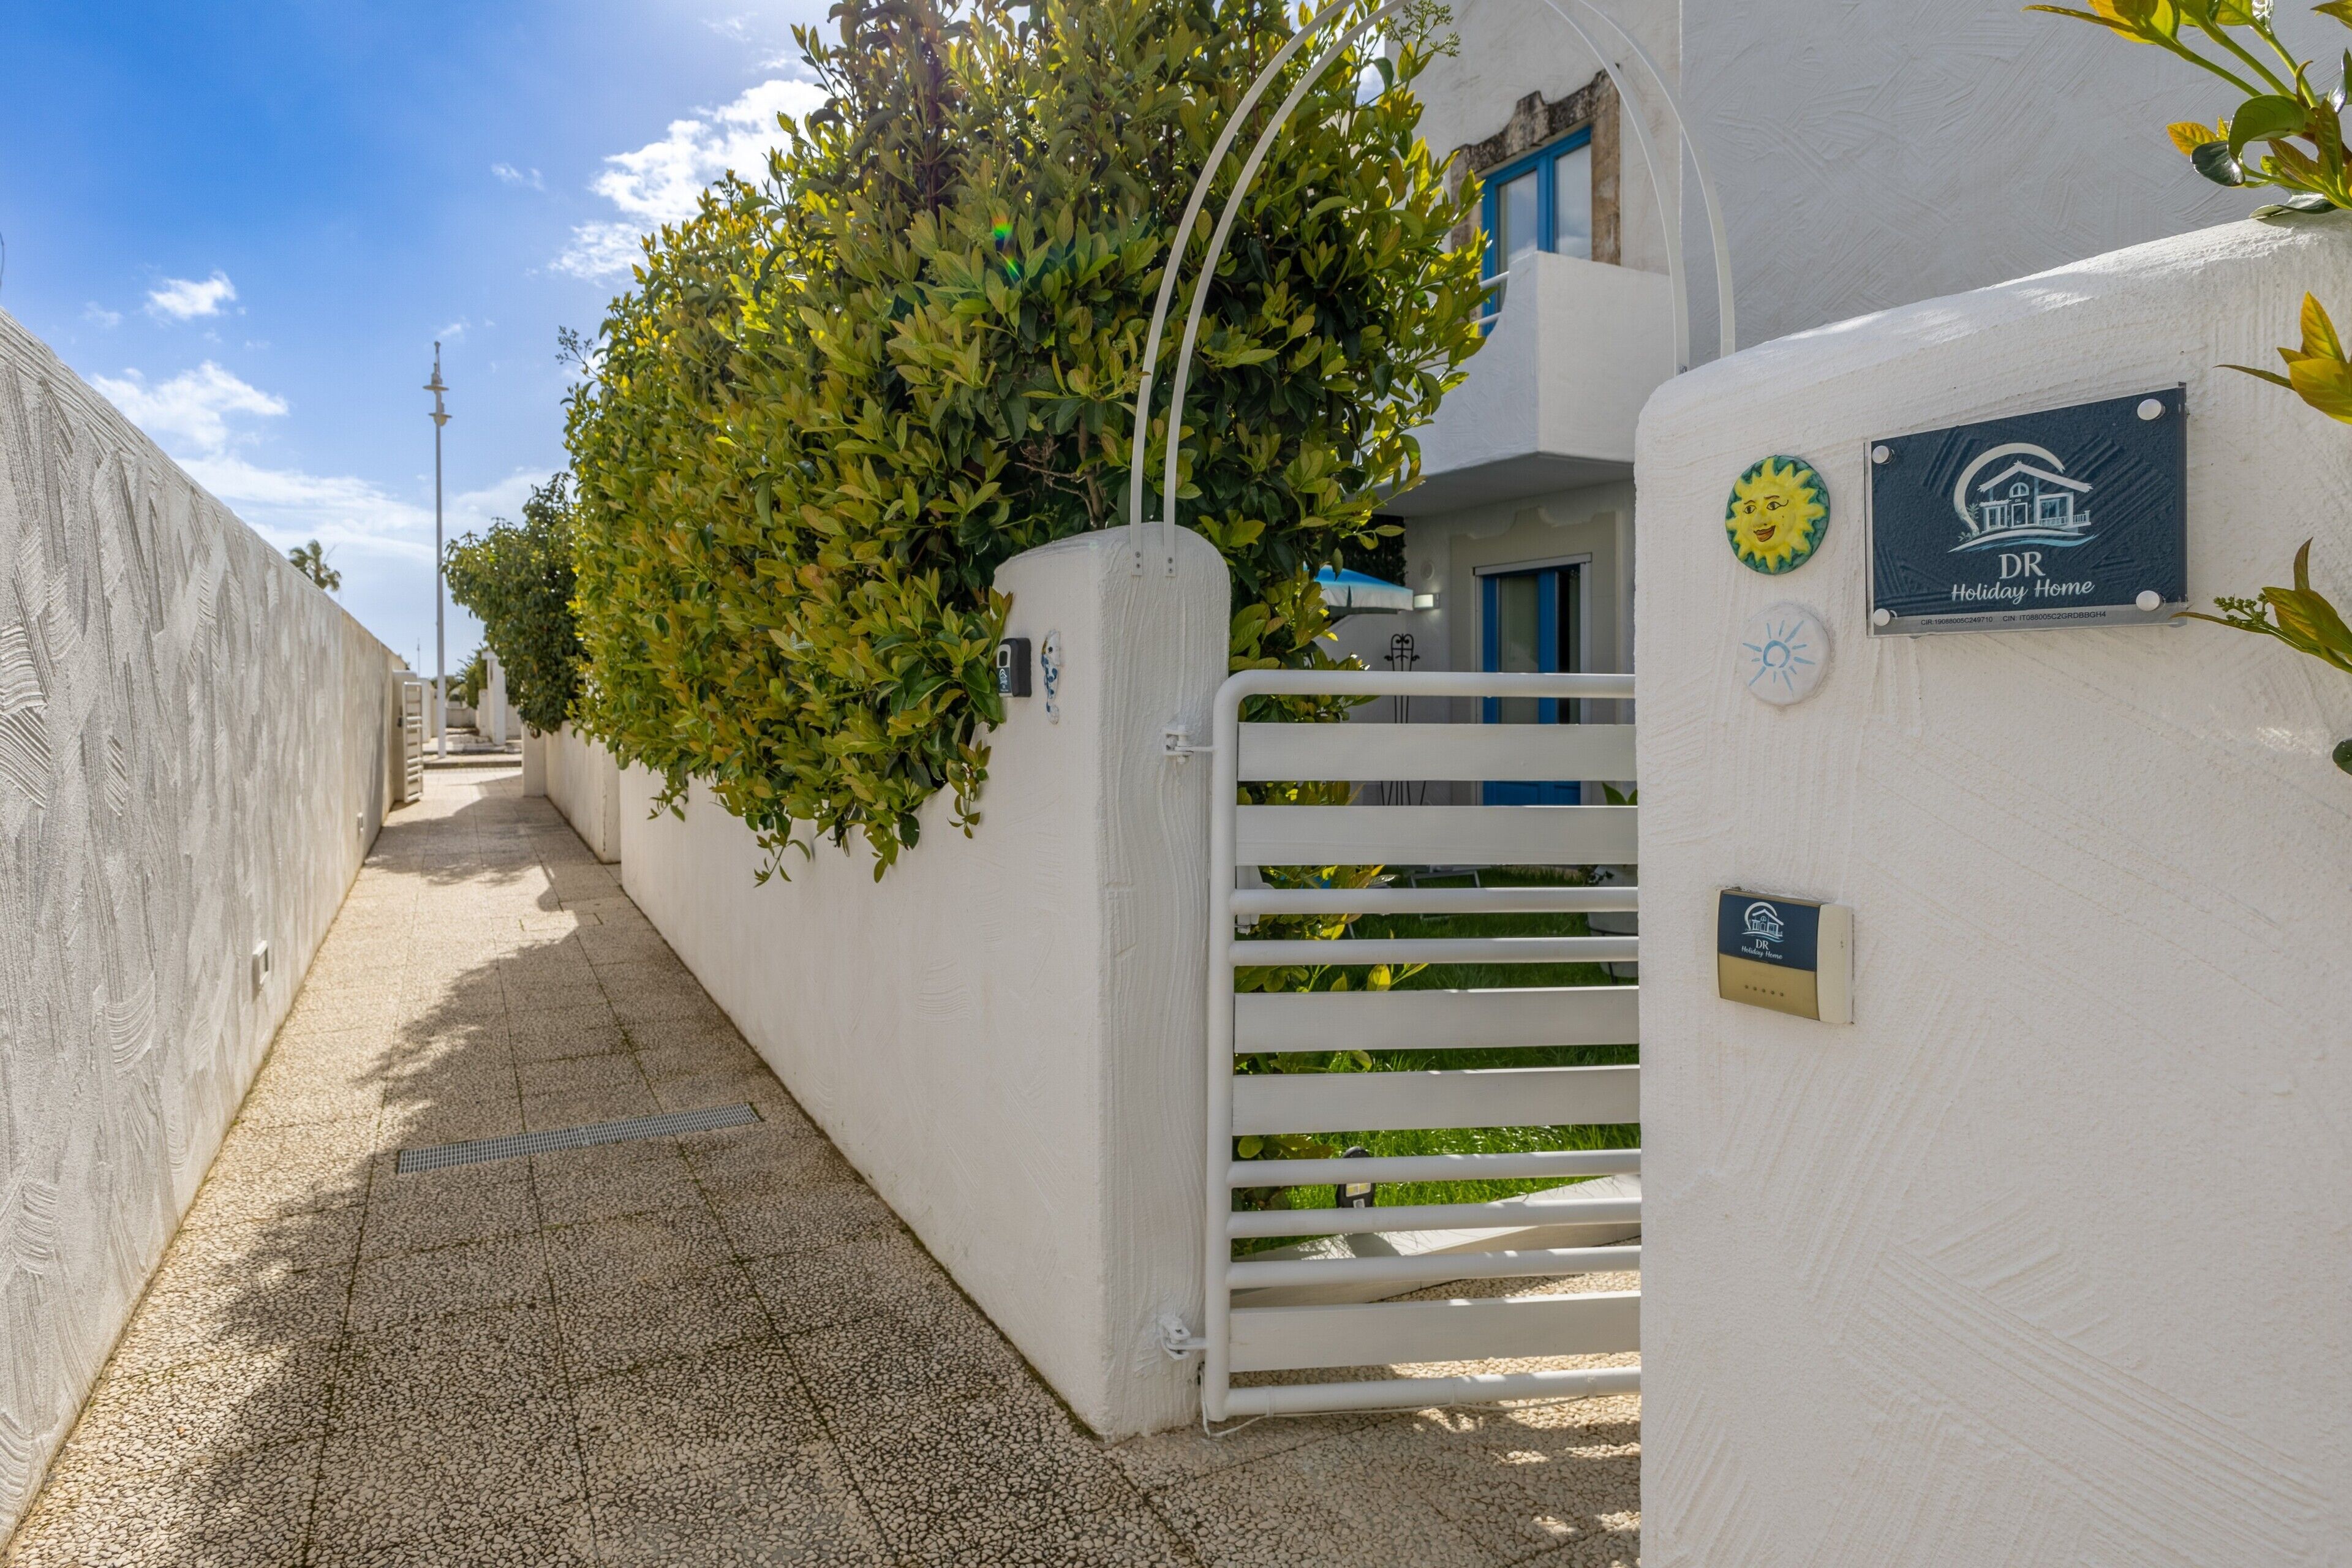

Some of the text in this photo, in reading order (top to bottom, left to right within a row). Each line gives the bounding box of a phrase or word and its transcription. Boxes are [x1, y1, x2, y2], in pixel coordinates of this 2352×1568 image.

[1998, 551, 2046, 579] DR
[1951, 578, 2095, 605] Holiday Home
[1741, 945, 1784, 960] Holiday Home
[1755, 938, 1770, 951] DR
